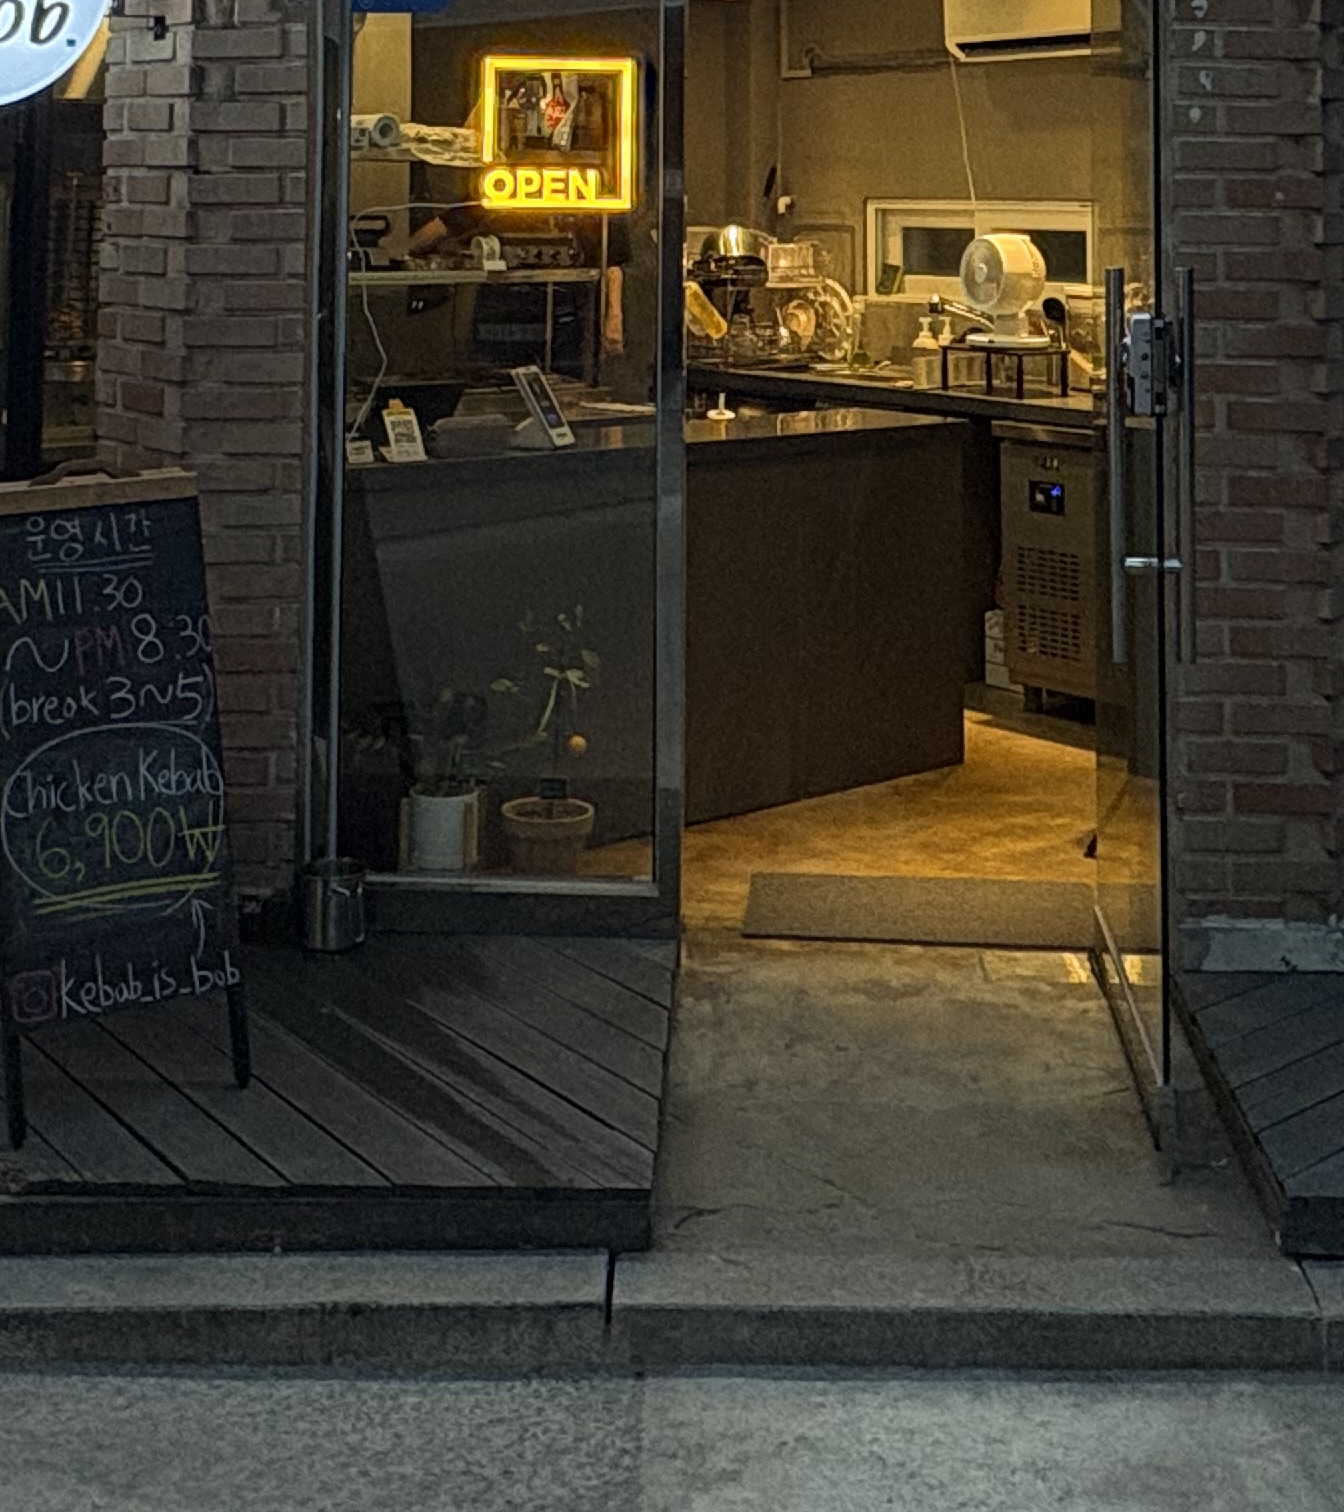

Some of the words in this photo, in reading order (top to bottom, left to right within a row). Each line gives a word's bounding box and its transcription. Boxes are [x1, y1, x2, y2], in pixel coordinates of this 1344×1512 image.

[484, 168, 598, 203] OPEN
[6, 757, 133, 819] Chicken
[137, 746, 223, 802] Kebab
[59, 949, 241, 1019] kebab_is_bob
